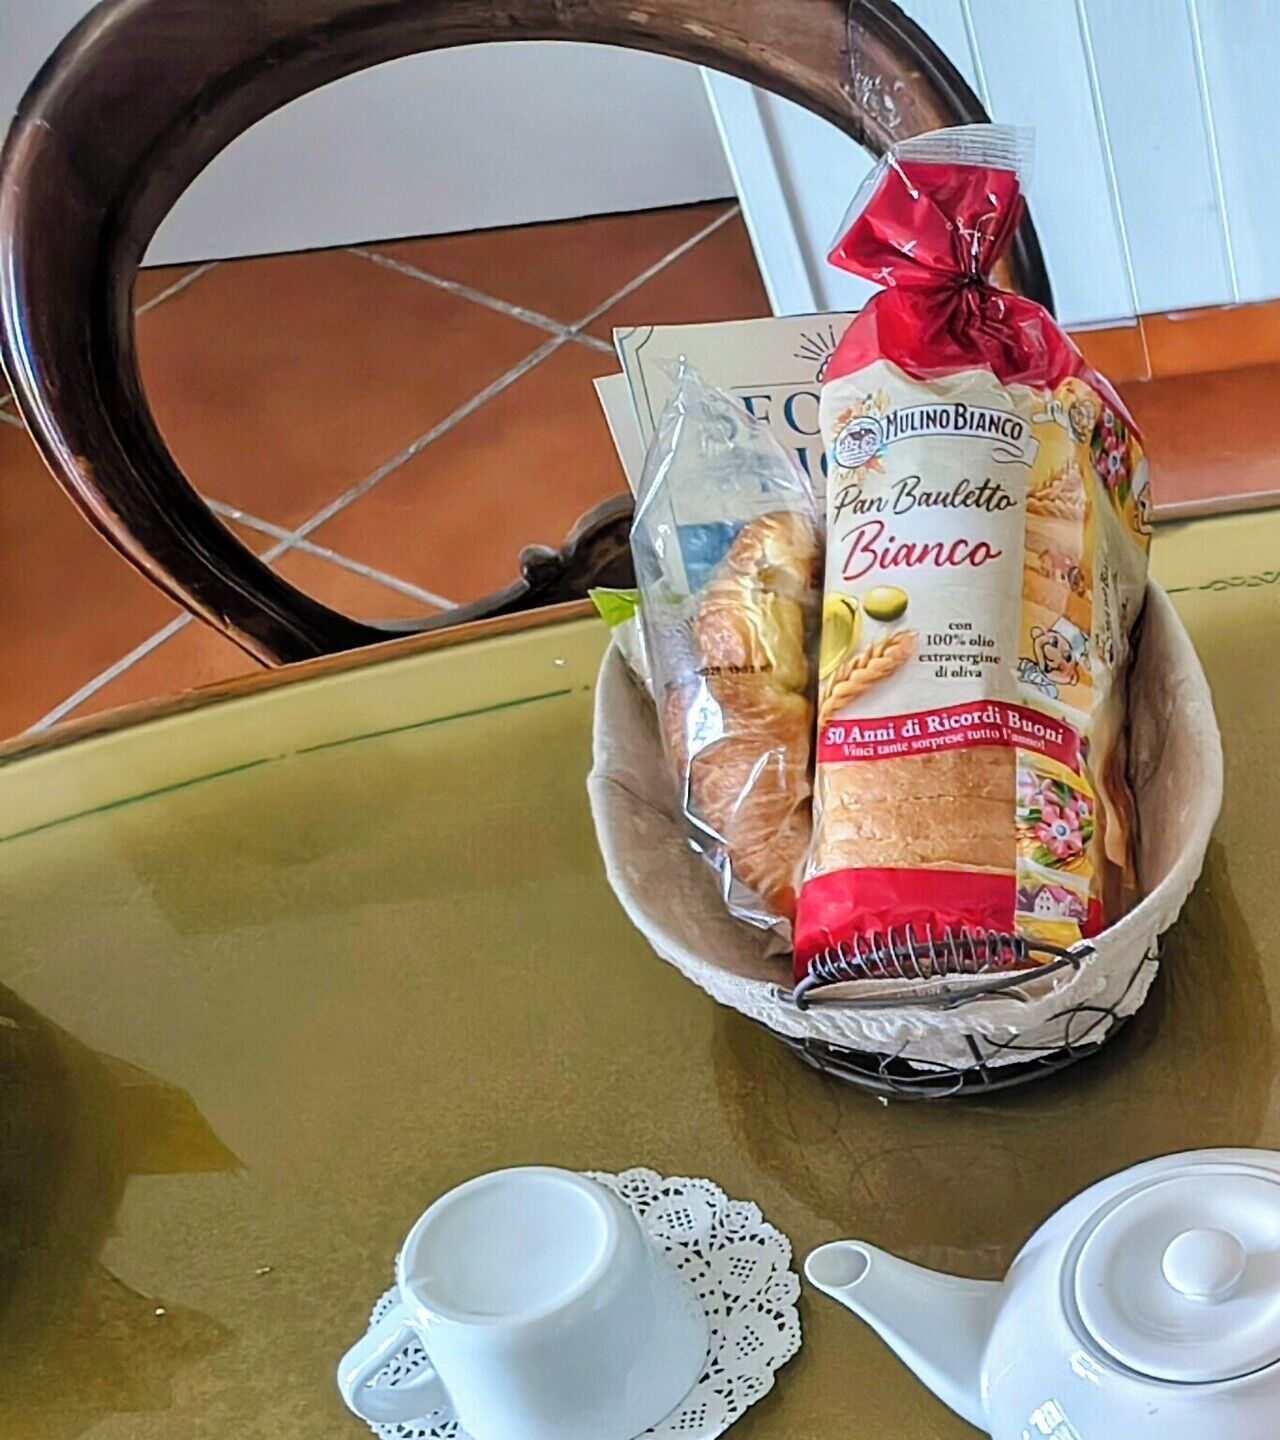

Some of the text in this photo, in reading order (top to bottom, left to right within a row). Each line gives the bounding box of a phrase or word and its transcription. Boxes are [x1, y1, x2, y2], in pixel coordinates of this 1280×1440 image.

[885, 403, 1024, 441] MULINO BIANCO
[834, 475, 1018, 525] Pan Bauletto
[841, 520, 1002, 582] Bianco
[948, 621, 972, 631] con
[926, 634, 995, 648] 100% olio
[918, 653, 1001, 666] extravergine
[935, 667, 982, 678] di oliva
[826, 705, 1064, 745] 50 Anni di Ricordi Buoni
[877, 741, 908, 755] tante
[911, 732, 964, 752] sorprese
